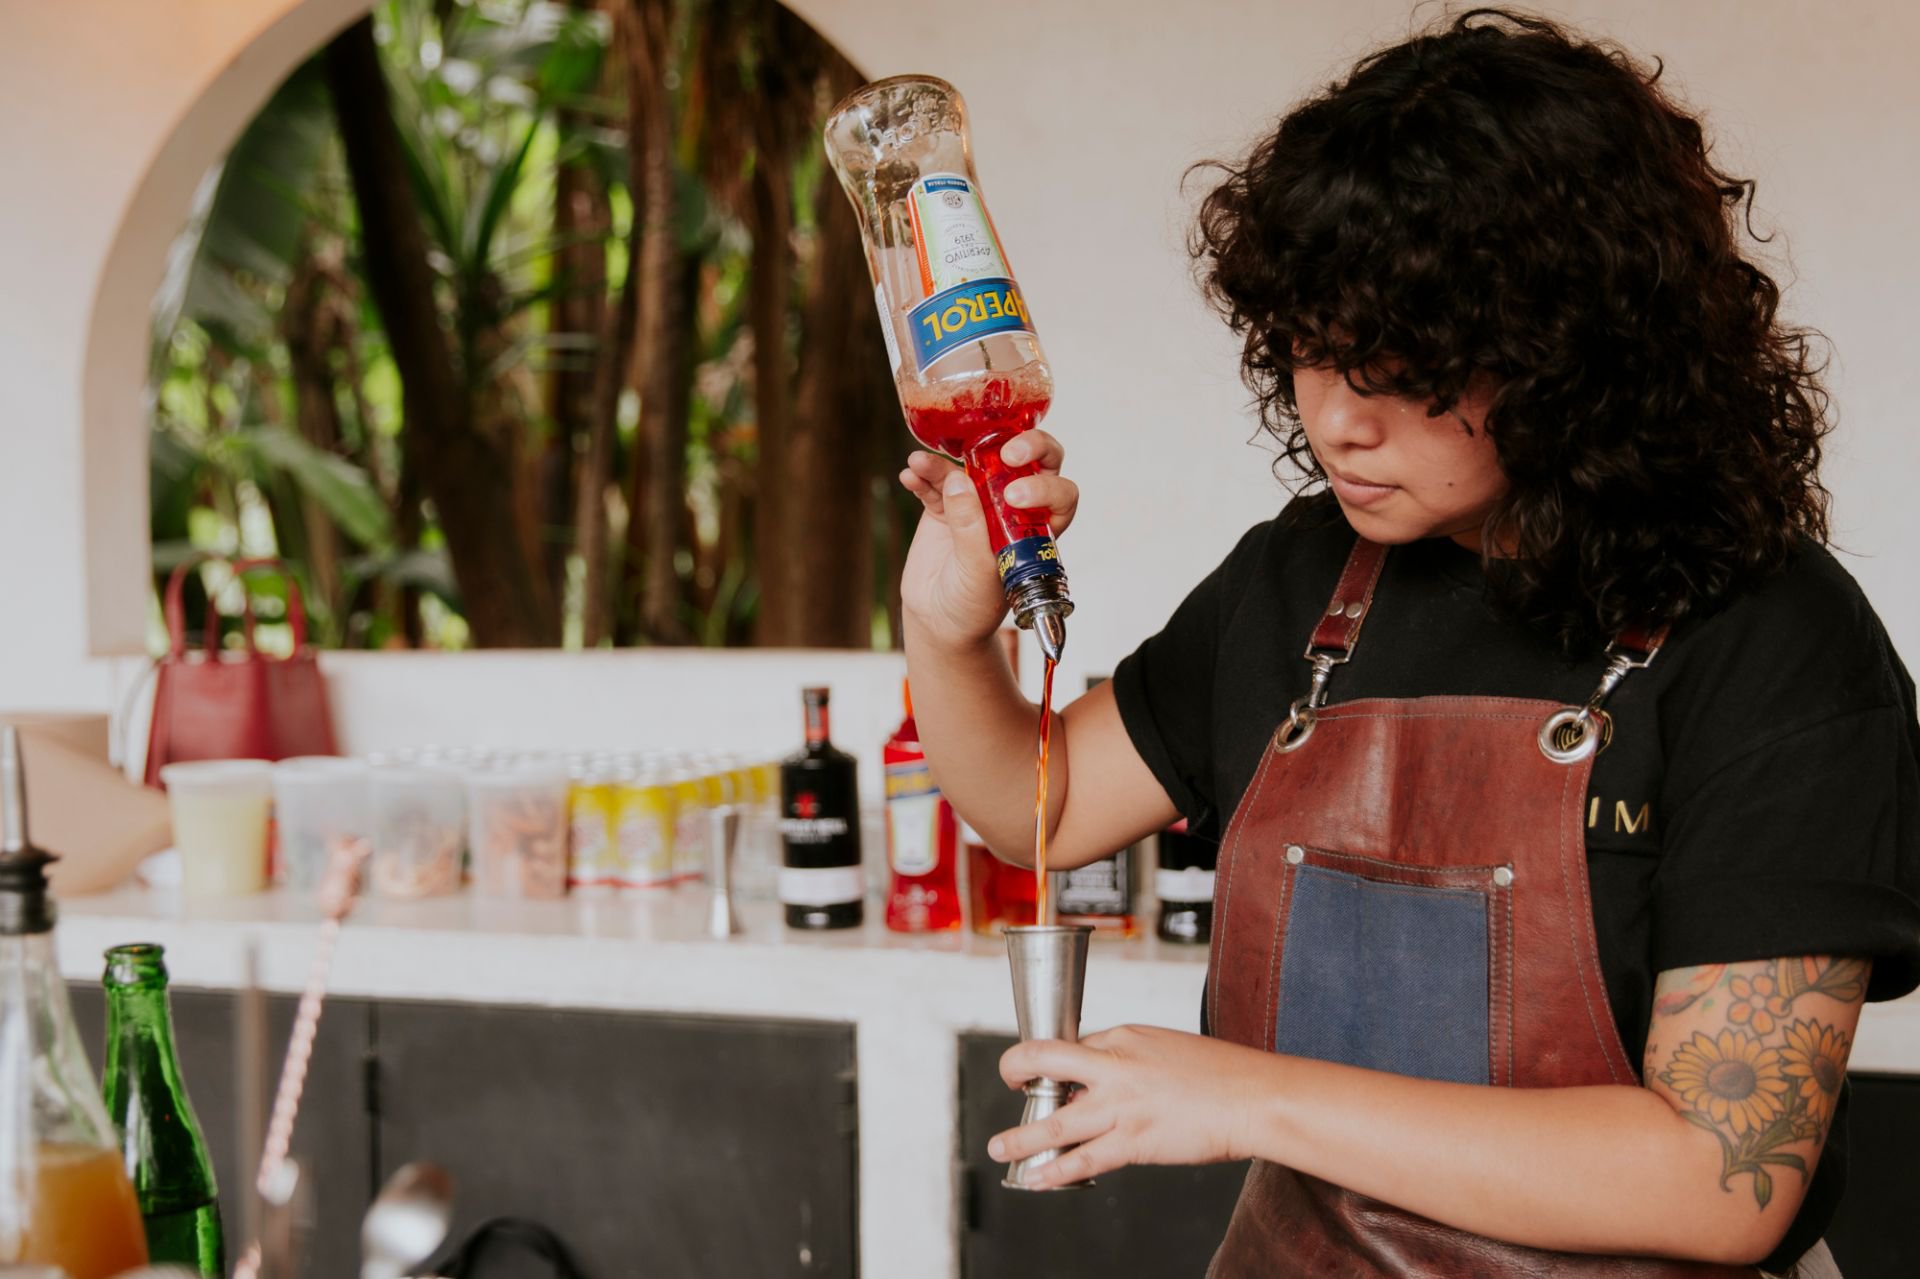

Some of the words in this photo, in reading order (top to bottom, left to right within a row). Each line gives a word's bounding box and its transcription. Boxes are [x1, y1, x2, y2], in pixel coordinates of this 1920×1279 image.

[955, 233, 975, 245] 1919
[944, 247, 991, 264] APERITIVO
[922, 288, 1030, 342] APEROL
